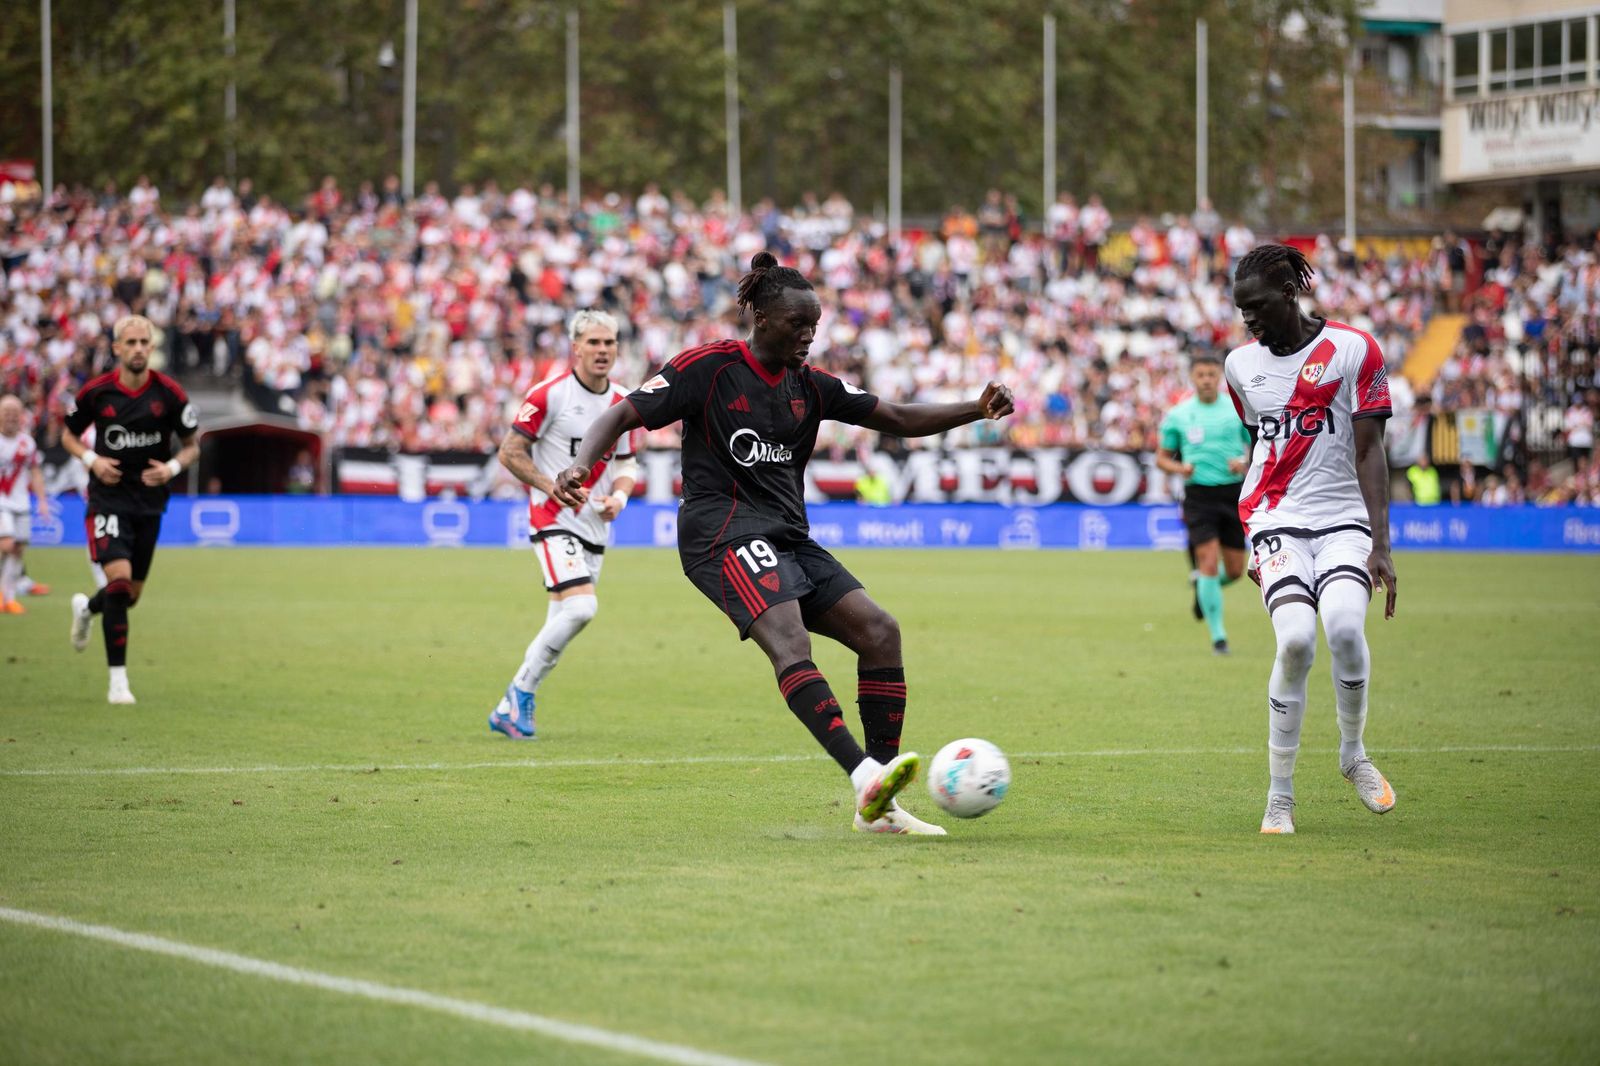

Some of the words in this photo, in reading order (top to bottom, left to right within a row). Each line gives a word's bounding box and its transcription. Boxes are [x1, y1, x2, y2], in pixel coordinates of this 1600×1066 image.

[1260, 406, 1336, 441] DIGI
[94, 514, 119, 538] 24
[562, 537, 577, 556] 3
[735, 539, 778, 574] 19
[814, 696, 839, 714] SFC
